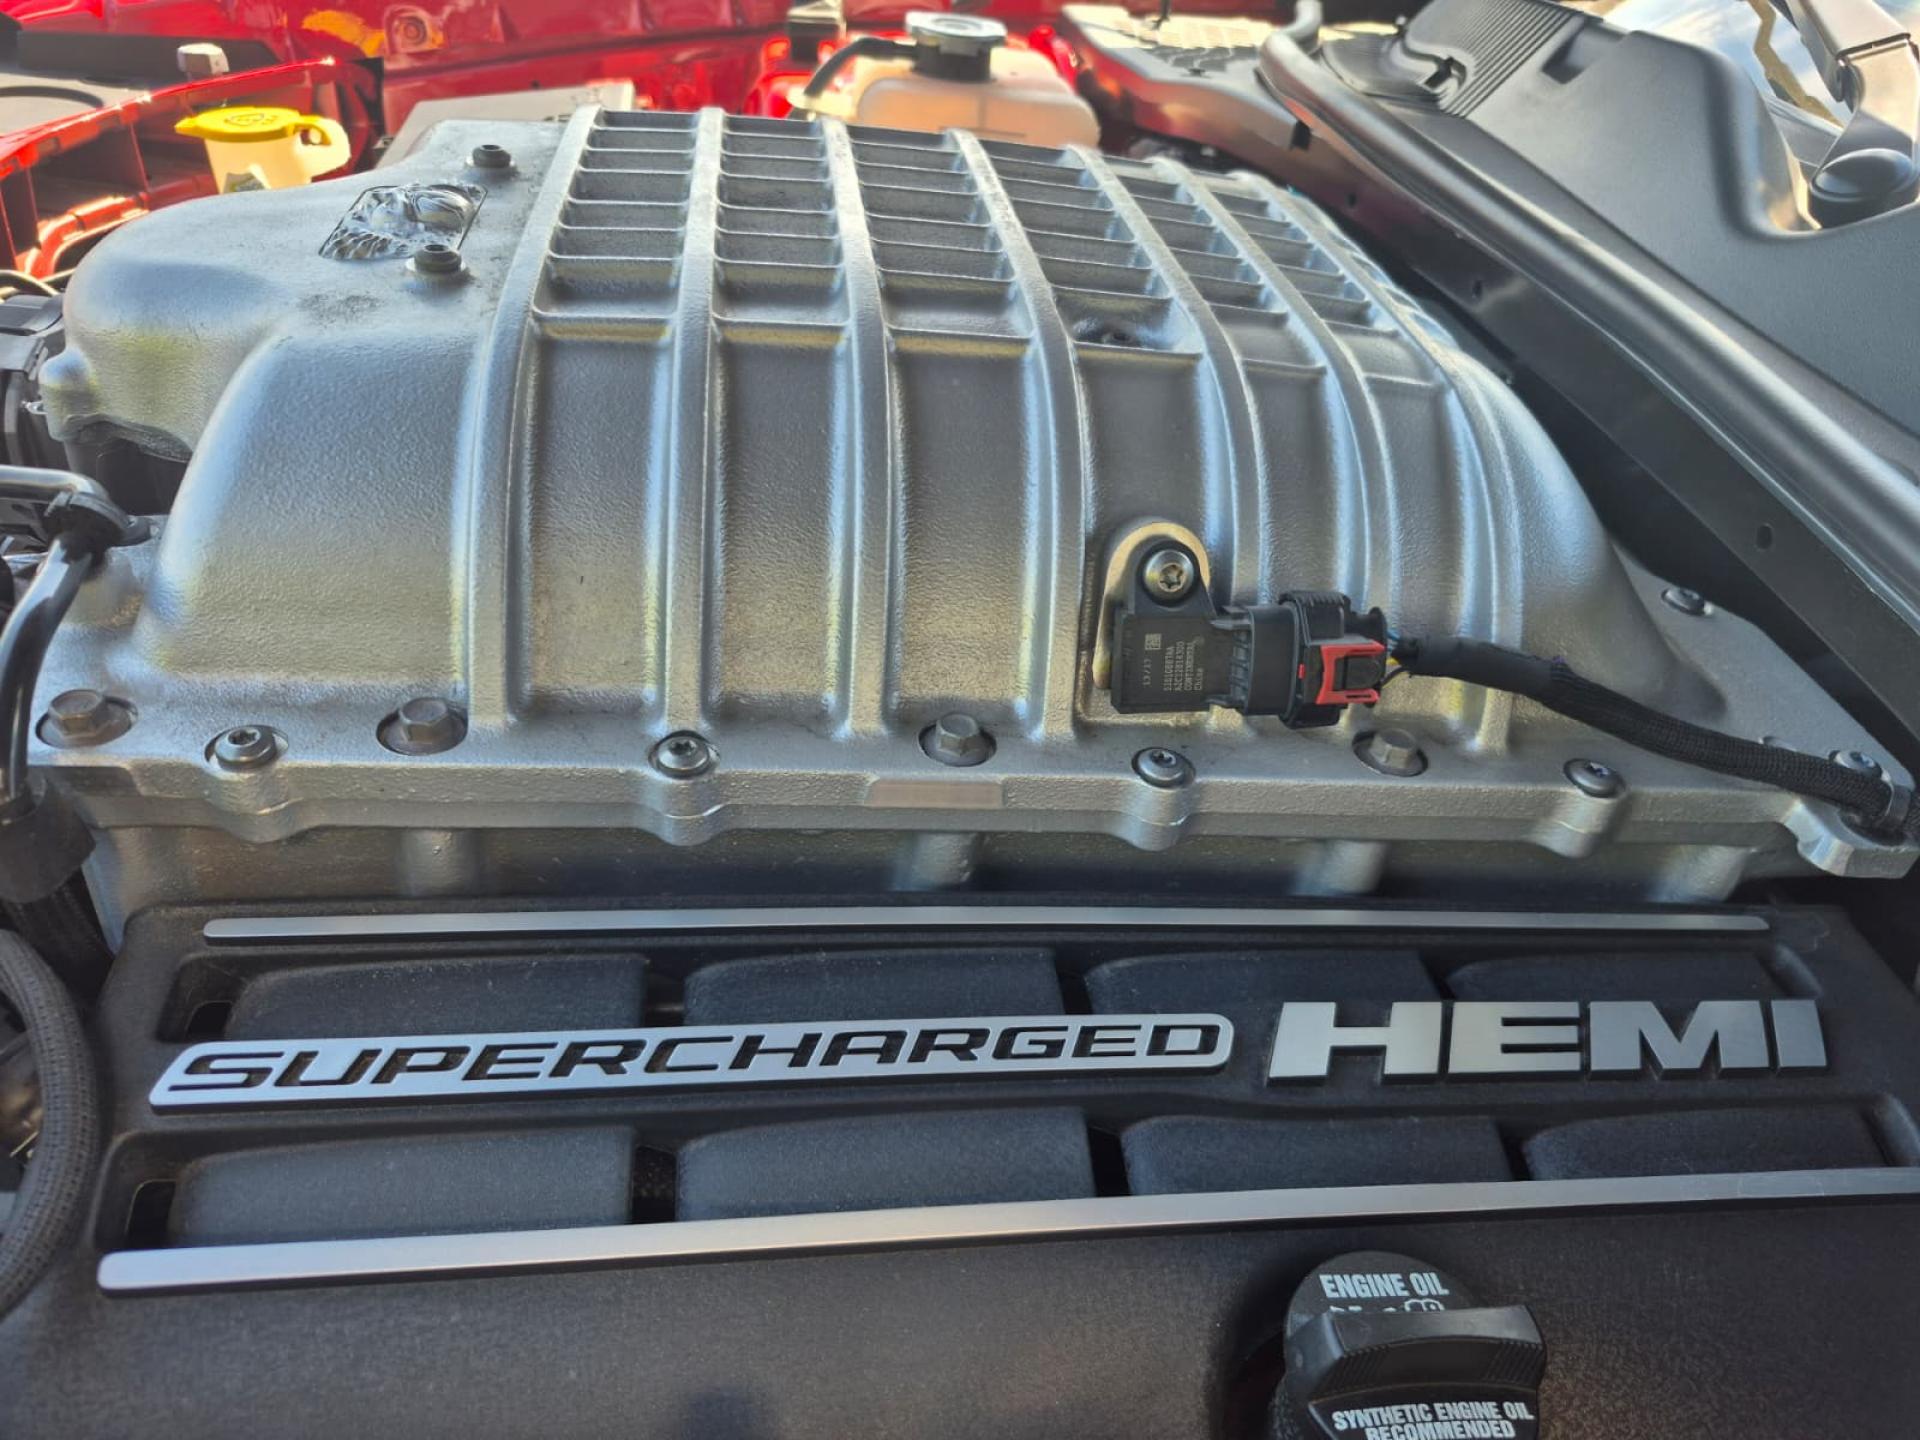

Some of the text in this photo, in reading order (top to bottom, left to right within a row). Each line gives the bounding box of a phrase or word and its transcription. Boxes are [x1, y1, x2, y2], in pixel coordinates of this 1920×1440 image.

[1269, 1001, 1827, 1078] HEMI
[167, 1024, 1221, 1092] SUPERCHARGED
[1319, 1272, 1450, 1298] ENGINE OIL
[1331, 1401, 1535, 1431] SYNTHETIC ENGINE OIL
[1365, 1420, 1517, 1440] RECOMMENDED
